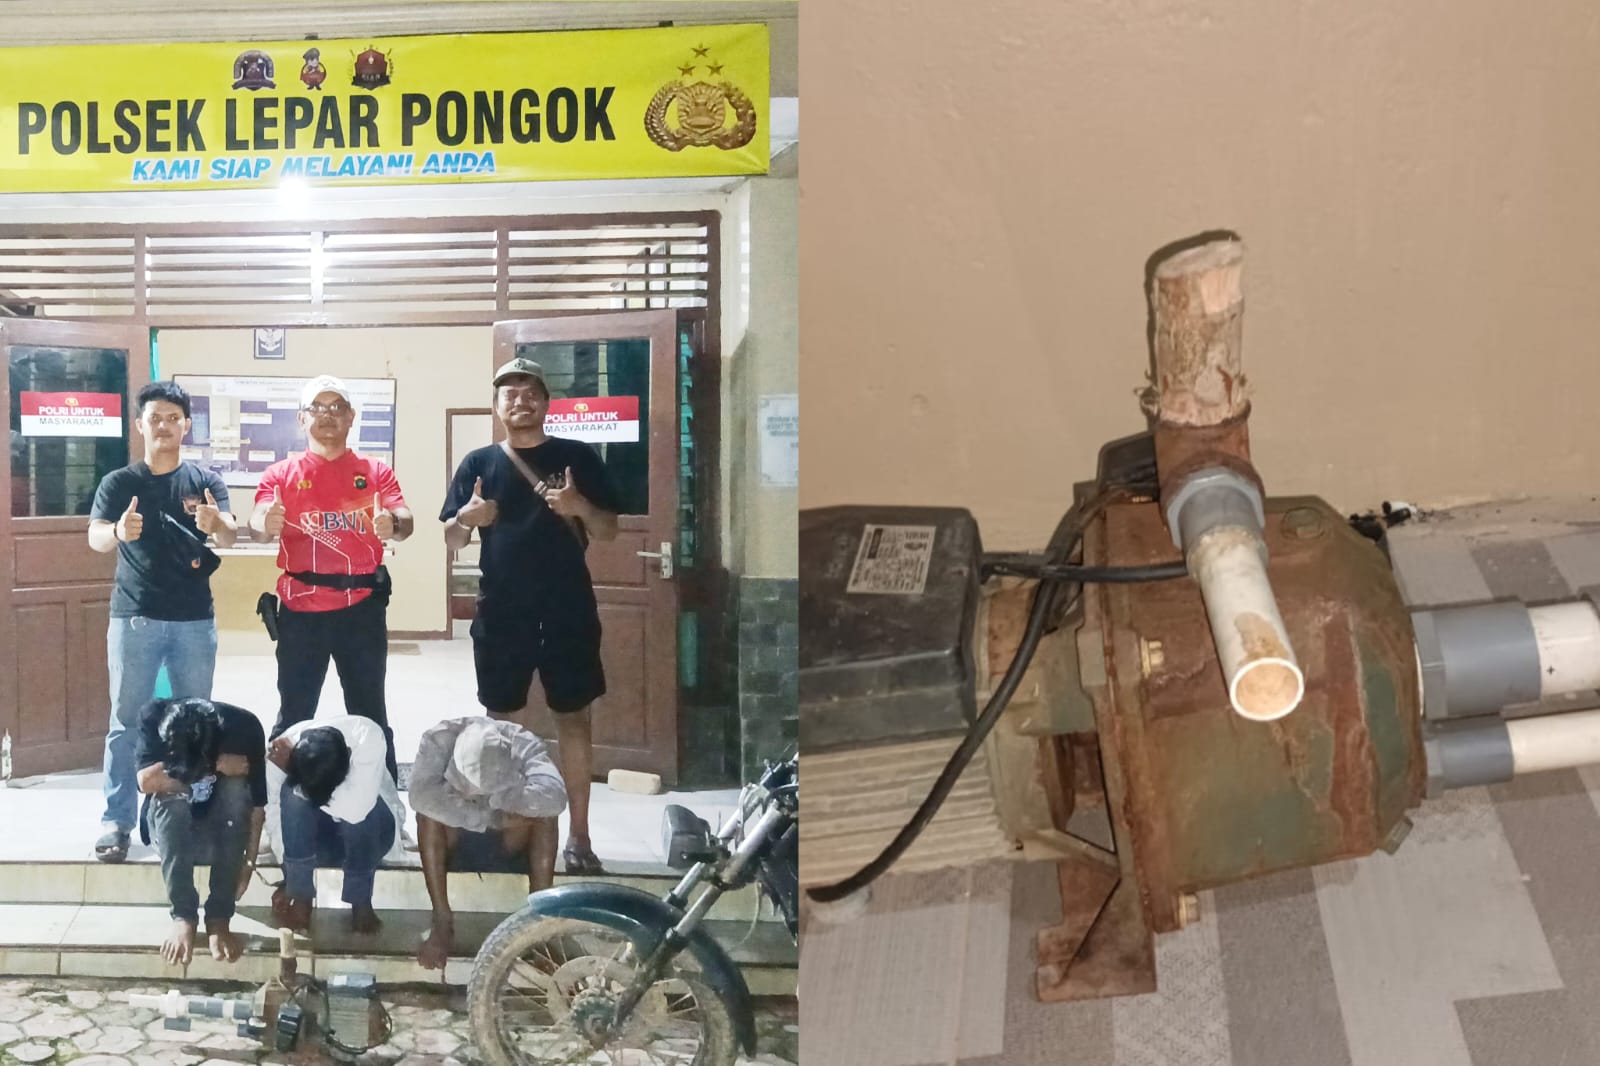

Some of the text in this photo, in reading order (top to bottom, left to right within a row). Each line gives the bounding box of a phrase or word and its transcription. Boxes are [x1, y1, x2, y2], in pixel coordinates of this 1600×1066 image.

[18, 87, 616, 155] POLSEK LEPAR PONGOK
[133, 151, 495, 181] KAMI SIAP MELAYANI ANDA
[38, 406, 104, 416] POLRI UNTUK
[39, 417, 104, 425] MASYARAKAT
[545, 411, 618, 423] POLRI UNTUK
[544, 423, 618, 433] MASYARAKAT
